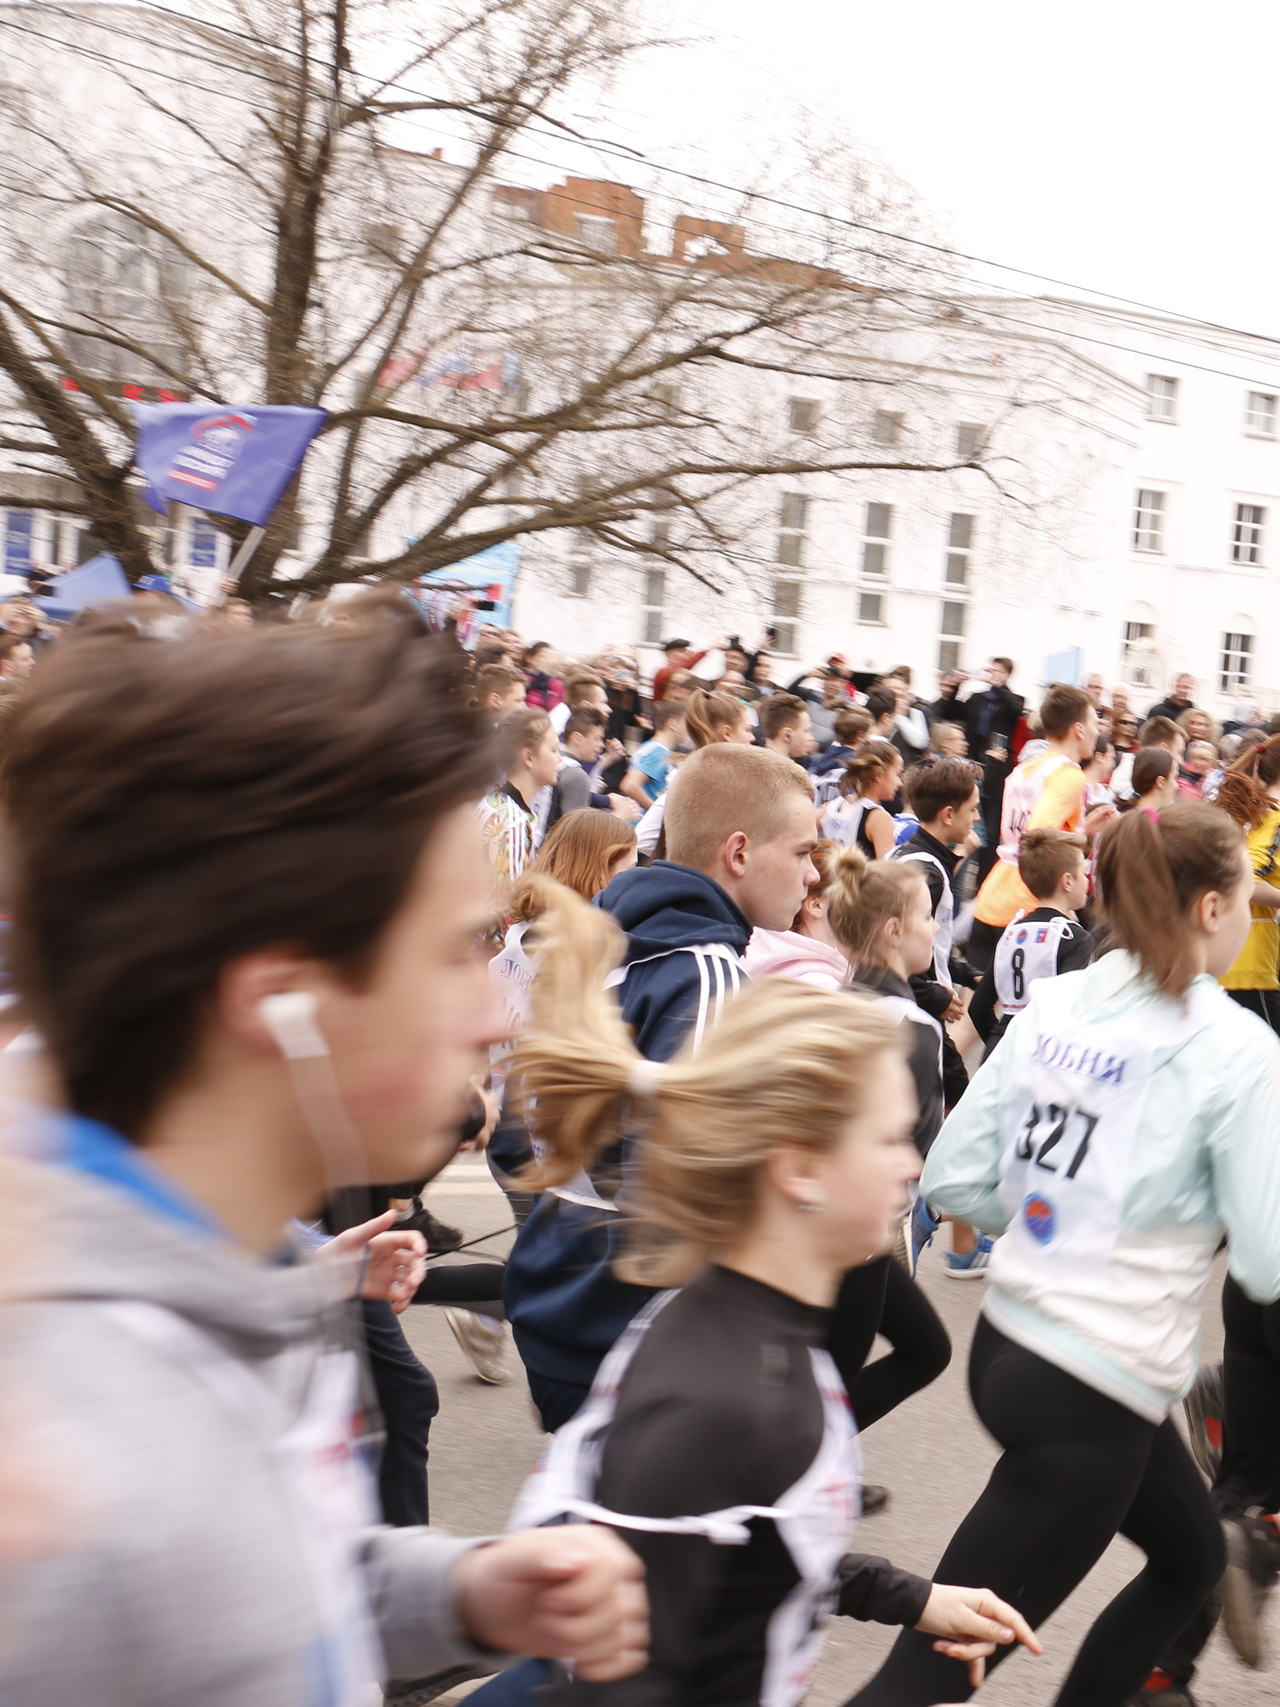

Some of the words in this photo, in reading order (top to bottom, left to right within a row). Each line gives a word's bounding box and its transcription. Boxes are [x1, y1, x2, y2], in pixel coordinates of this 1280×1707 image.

[500, 958, 536, 991] ЛОБН
[1012, 948, 1025, 1000] 8
[1016, 1101, 1099, 1180] 327
